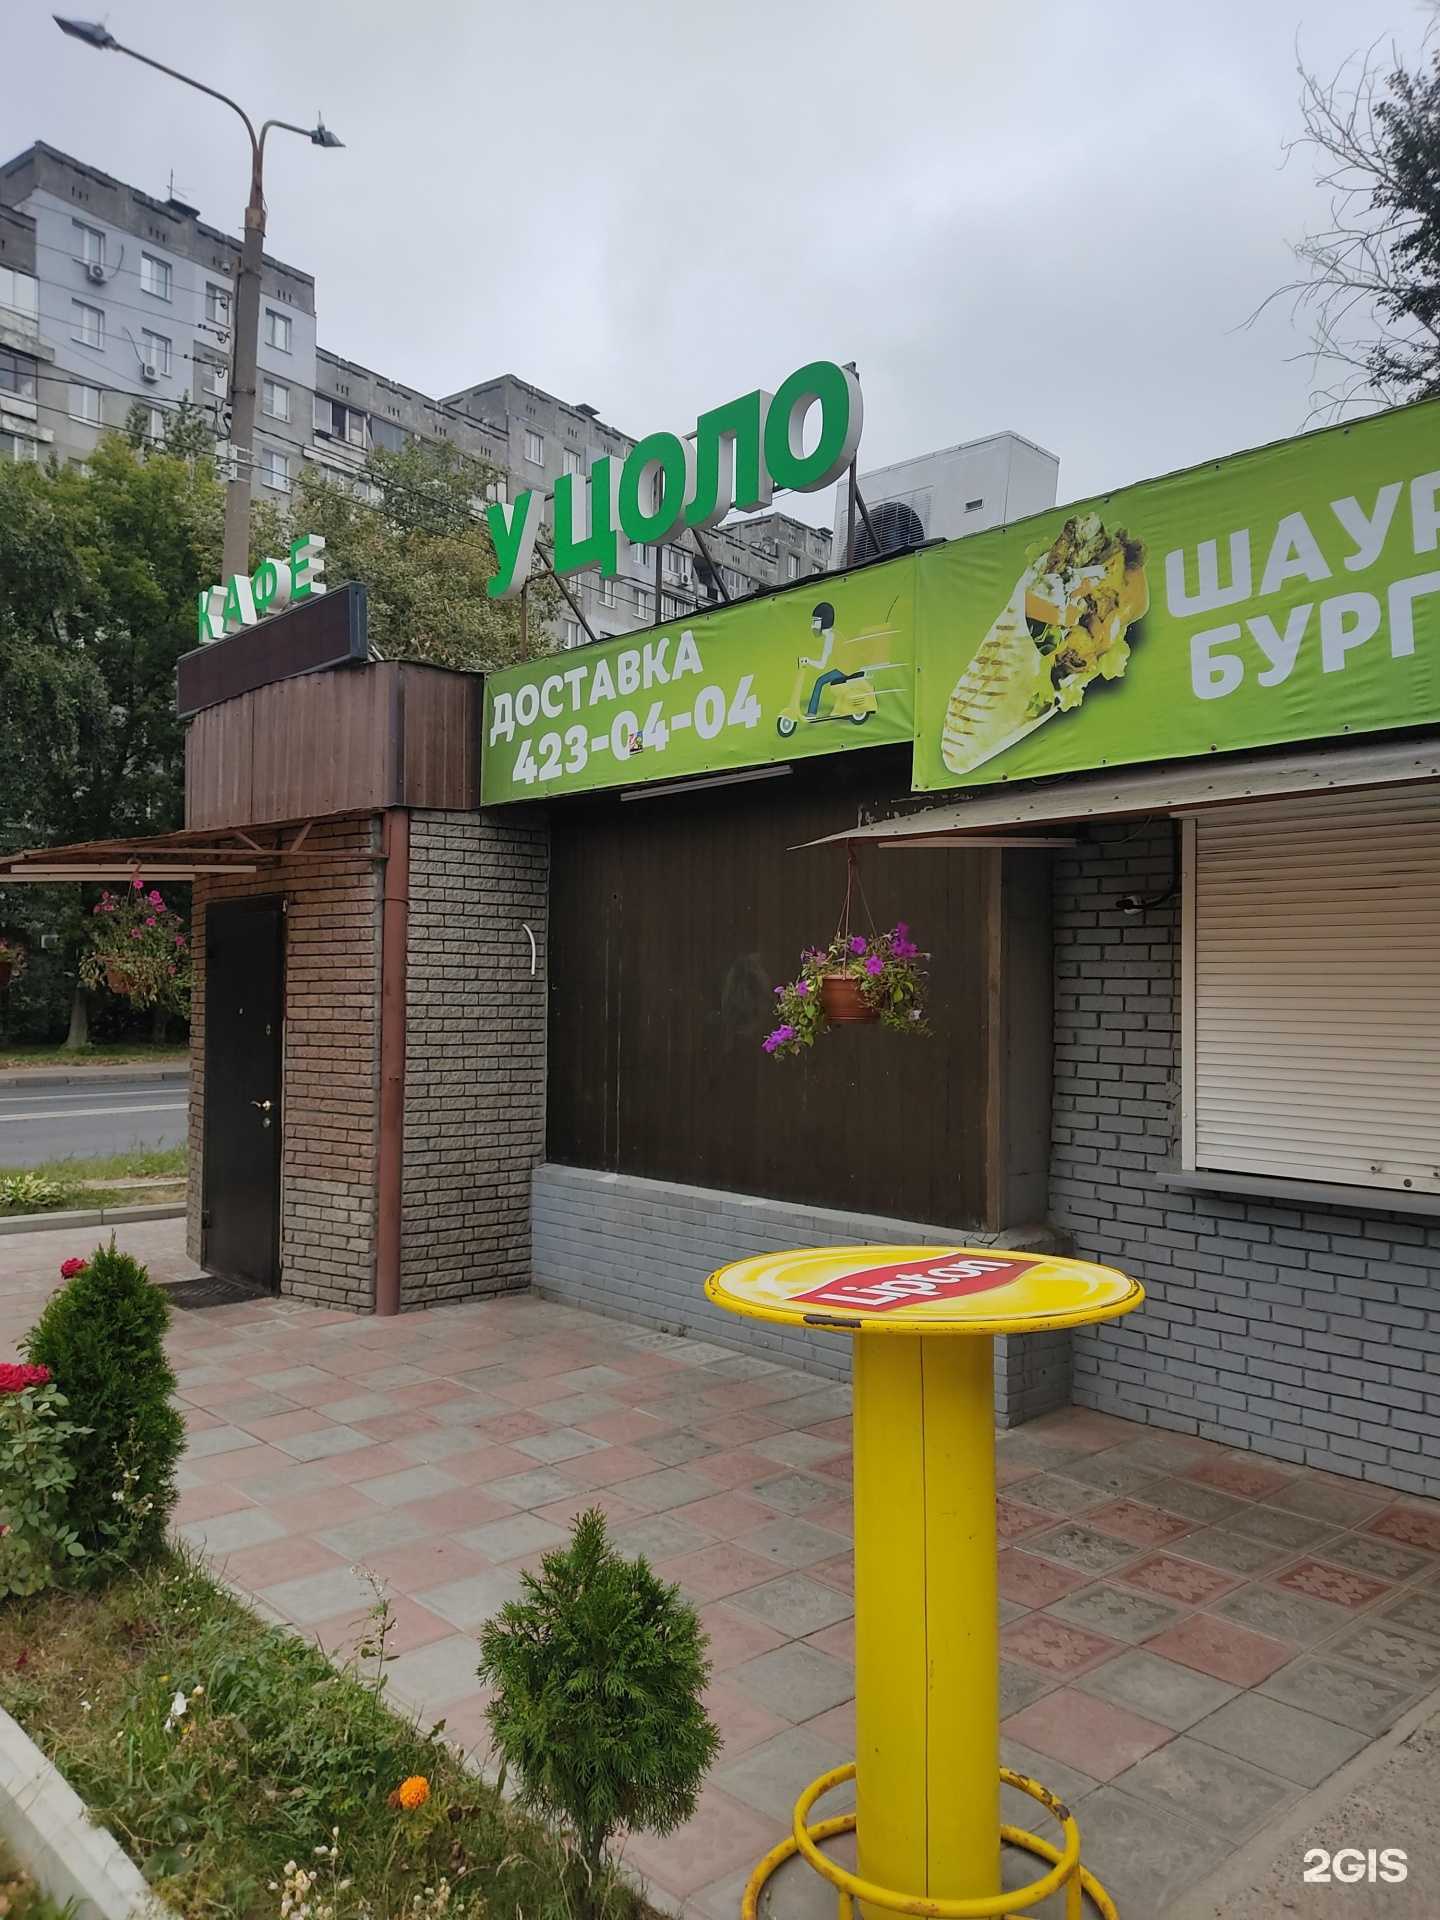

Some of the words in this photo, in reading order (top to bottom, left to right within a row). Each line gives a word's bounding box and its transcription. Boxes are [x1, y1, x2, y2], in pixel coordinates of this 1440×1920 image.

[487, 488, 543, 598] У
[554, 360, 863, 581] ЦОЛО
[198, 533, 327, 644] КАФЕ
[489, 630, 704, 747] ДОСТАВКА
[512, 674, 761, 785] 423-04-04
[816, 1259, 1015, 1307] Lipton
